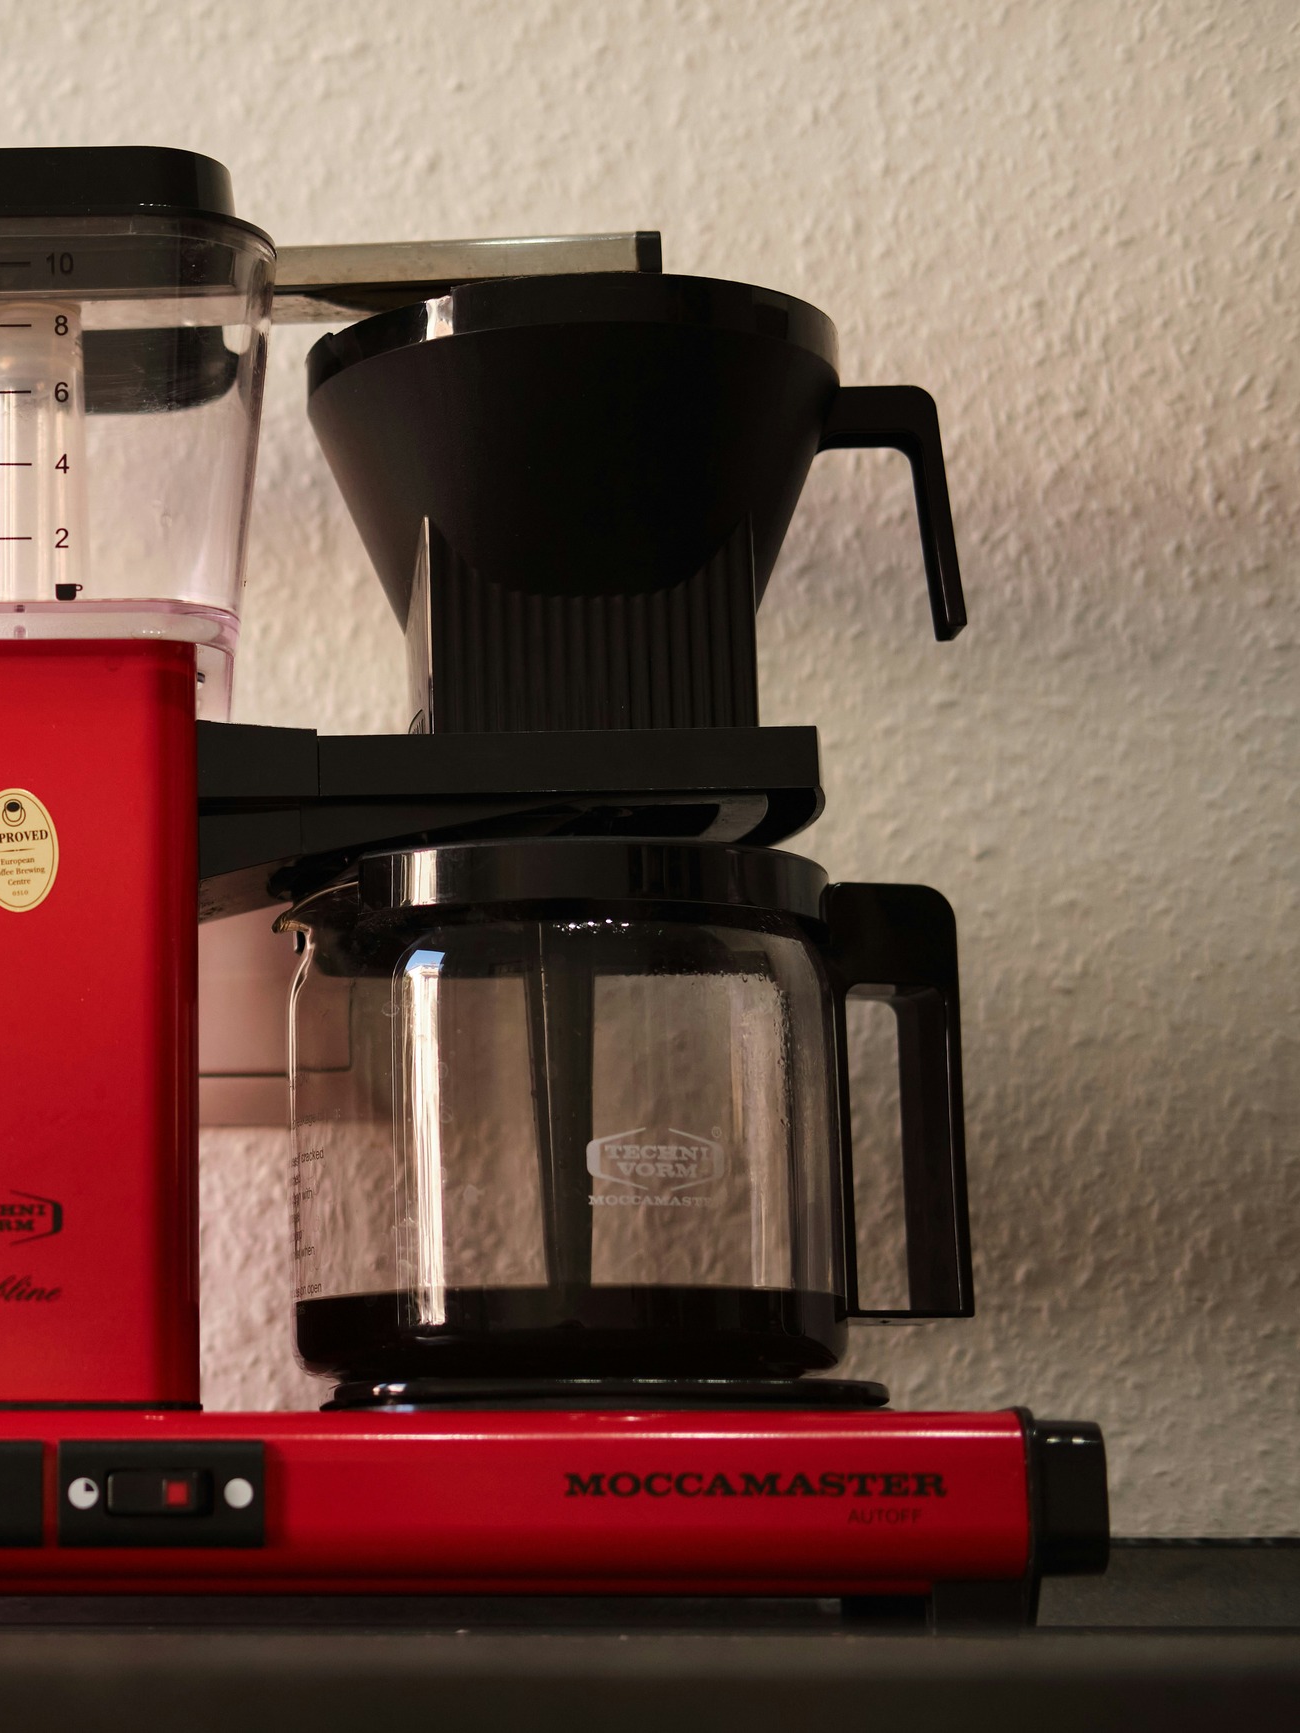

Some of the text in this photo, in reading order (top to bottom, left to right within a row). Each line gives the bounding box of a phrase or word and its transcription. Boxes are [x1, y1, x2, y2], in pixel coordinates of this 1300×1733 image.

[46, 252, 74, 276] 10
[54, 315, 69, 336] 8
[54, 382, 69, 403] 6
[55, 453, 70, 474] 4
[55, 528, 69, 549] 2
[0, 857, 35, 866] European
[16, 866, 46, 875] Brewing
[7, 878, 31, 887] Centre
[300, 1147, 324, 1163] cracked
[604, 1144, 709, 1161] TECHNI
[617, 1162, 698, 1178] VORM
[588, 1194, 716, 1207] MOCCAMASTE
[307, 1283, 322, 1296] open
[564, 1472, 948, 1498] MOCCAMASTER
[847, 1507, 923, 1525] AUTOFF
